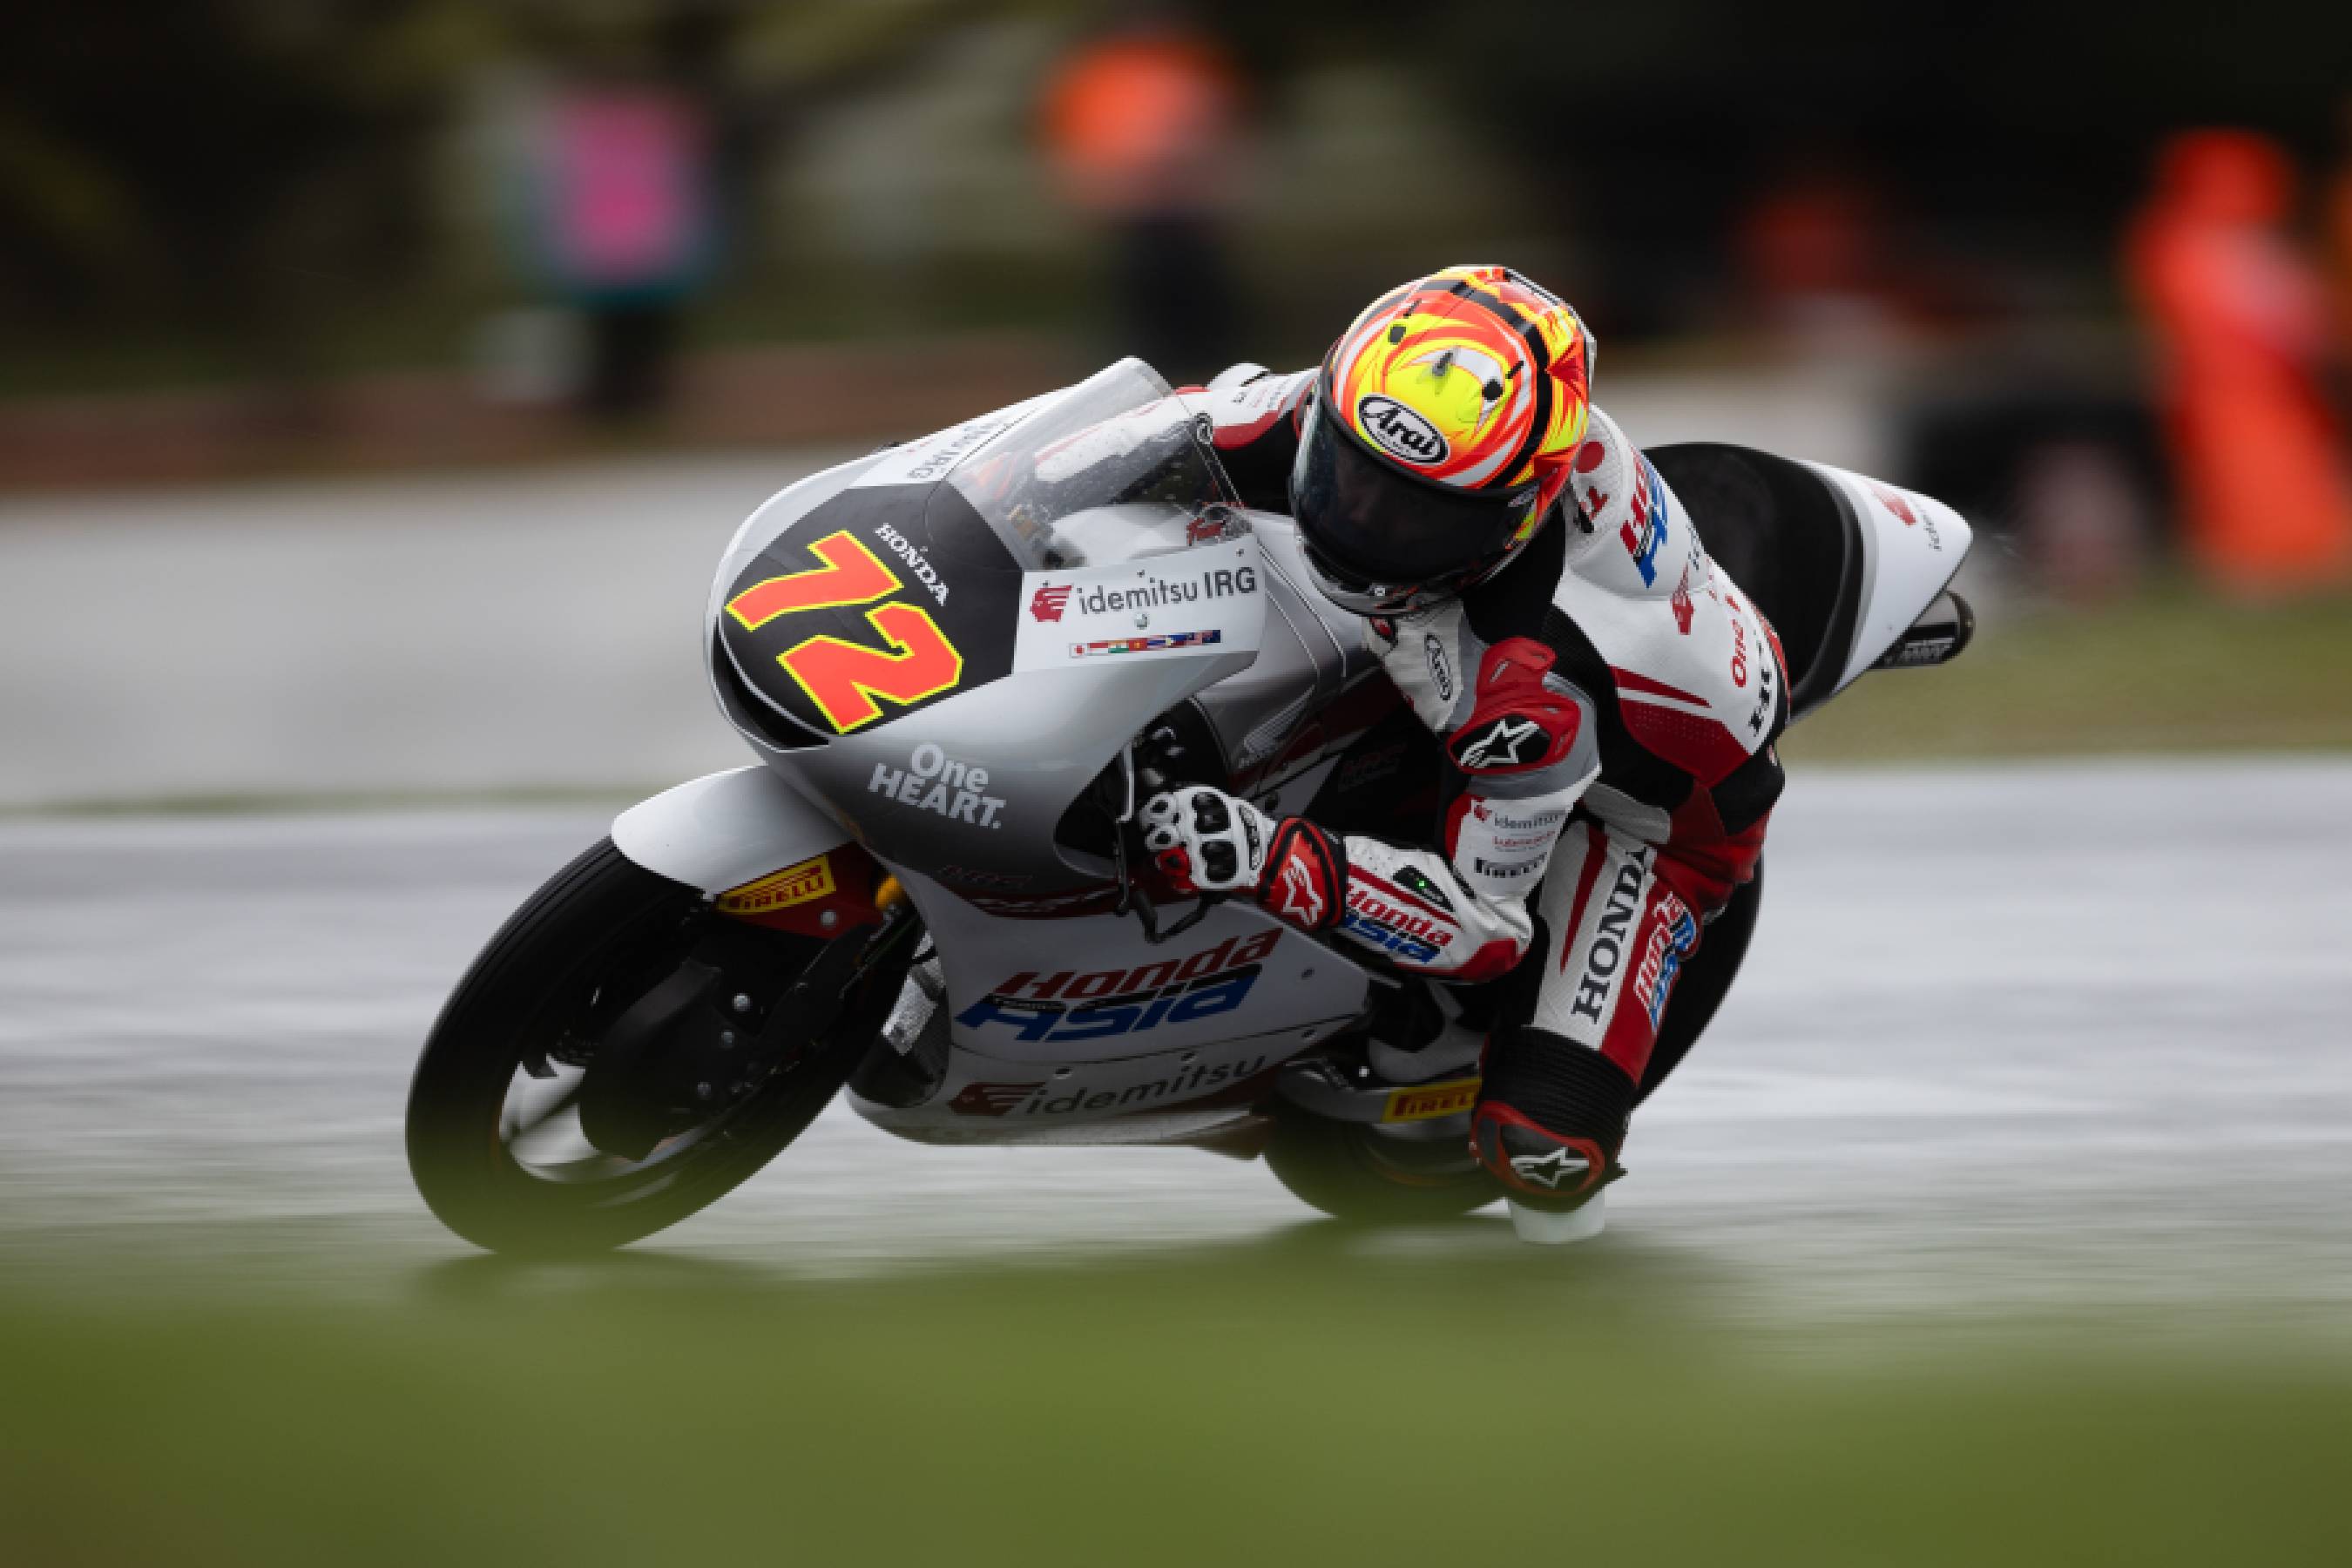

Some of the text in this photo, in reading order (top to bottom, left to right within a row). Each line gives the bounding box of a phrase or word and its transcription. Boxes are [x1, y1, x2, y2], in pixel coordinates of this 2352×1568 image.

[1360, 405, 1439, 456] Arai
[875, 523, 949, 606] HONDA
[1077, 566, 1258, 615] idemitsu IRG
[725, 530, 964, 735] 72
[867, 762, 1007, 828] HEART.
[910, 743, 990, 792] One
[993, 927, 1283, 1000] Honda
[955, 963, 1262, 1041] Asia
[1025, 1054, 1267, 1116] idemitsu
